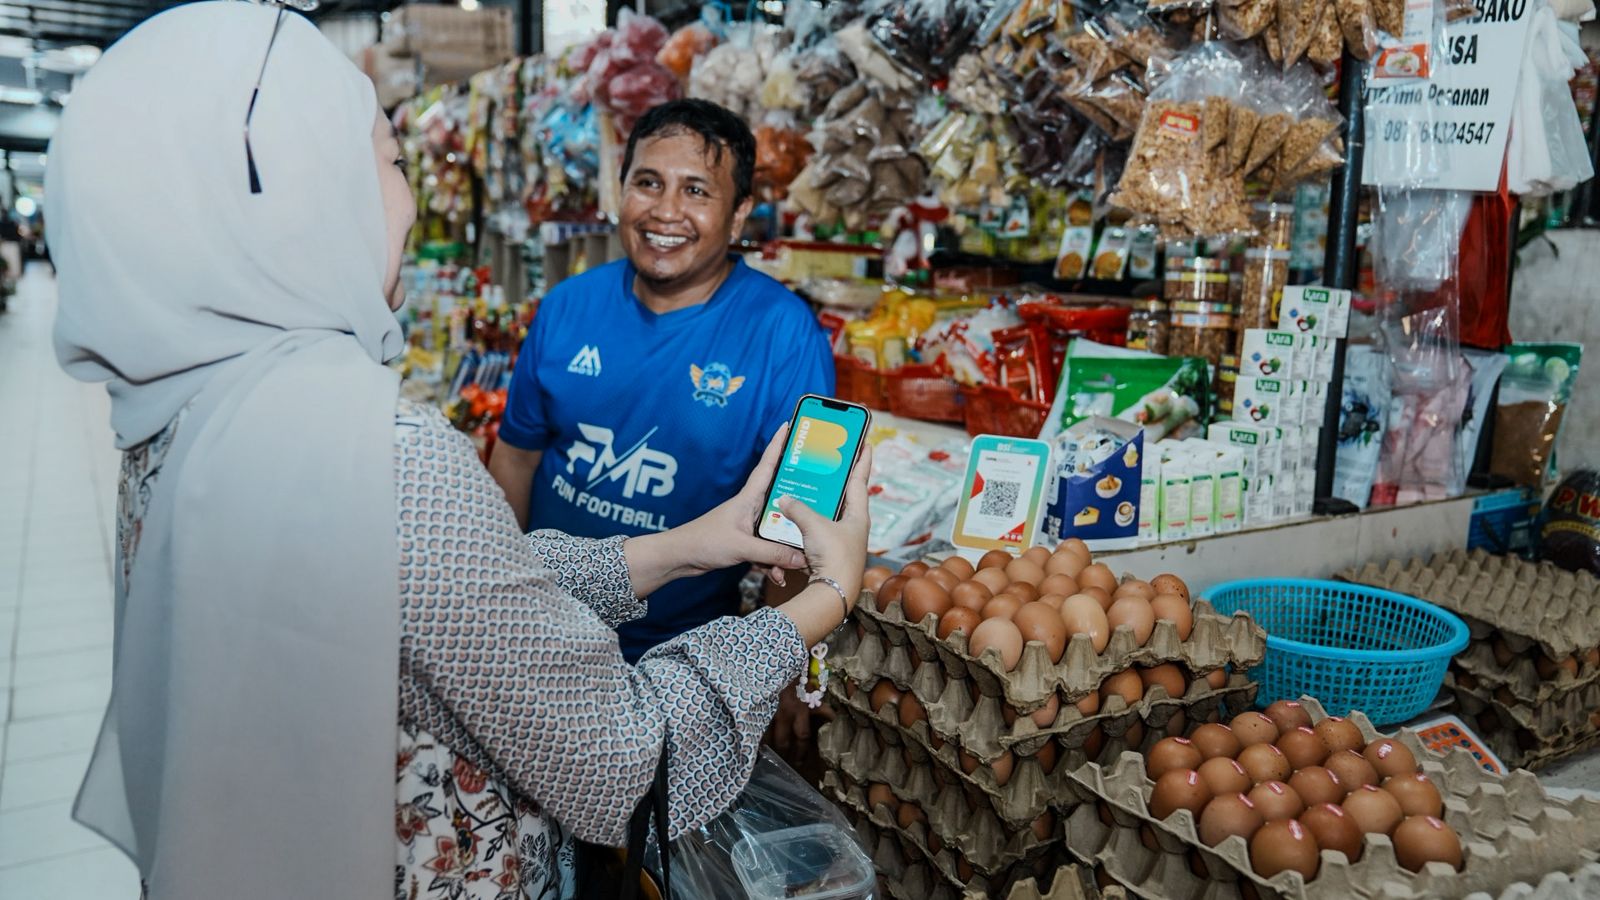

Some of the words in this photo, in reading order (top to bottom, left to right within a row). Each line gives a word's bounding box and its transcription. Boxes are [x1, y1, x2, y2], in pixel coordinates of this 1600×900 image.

[1466, 0, 1526, 24] BAKO
[552, 474, 576, 503] FUN
[576, 491, 670, 531] FOOTBALL
